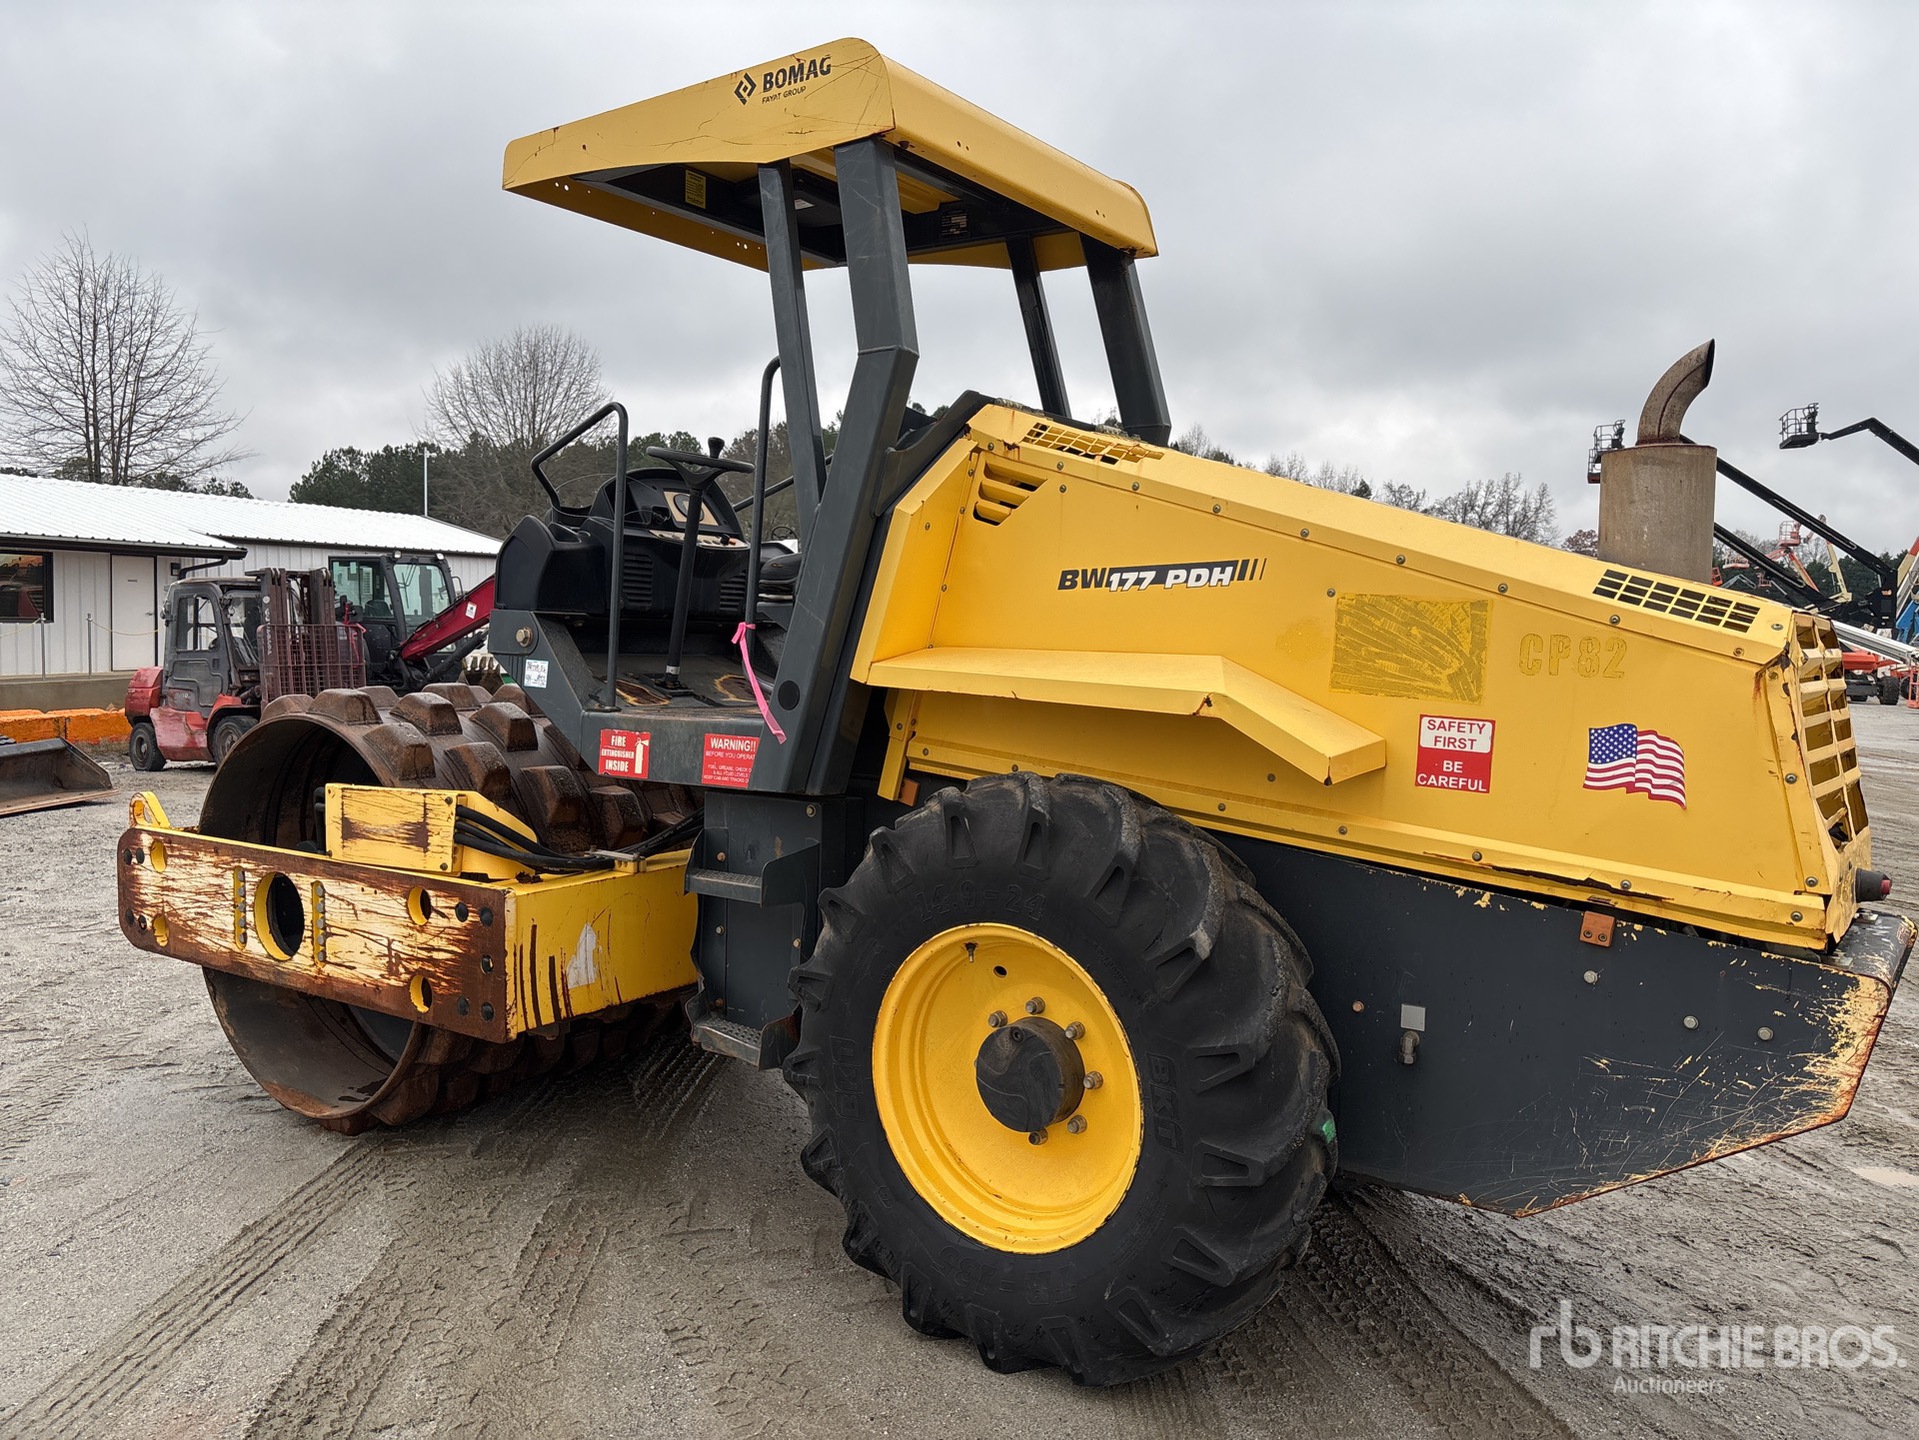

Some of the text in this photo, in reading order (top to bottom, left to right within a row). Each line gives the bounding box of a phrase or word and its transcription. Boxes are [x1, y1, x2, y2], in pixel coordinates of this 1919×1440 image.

[763, 56, 832, 93] BOMAG
[783, 86, 807, 98] GROUP
[1163, 566, 1234, 590] PDH
[1519, 633, 1628, 679] CP82
[1427, 719, 1486, 735] SAFETY
[611, 735, 627, 747] FIRE
[710, 737, 757, 752] WARNING!!
[1433, 735, 1477, 750] FIRST
[605, 759, 629, 772] INSIDE
[1443, 760, 1463, 773] BE
[1417, 773, 1487, 792] CAREFUL
[1147, 1053, 1183, 1153] BKT
